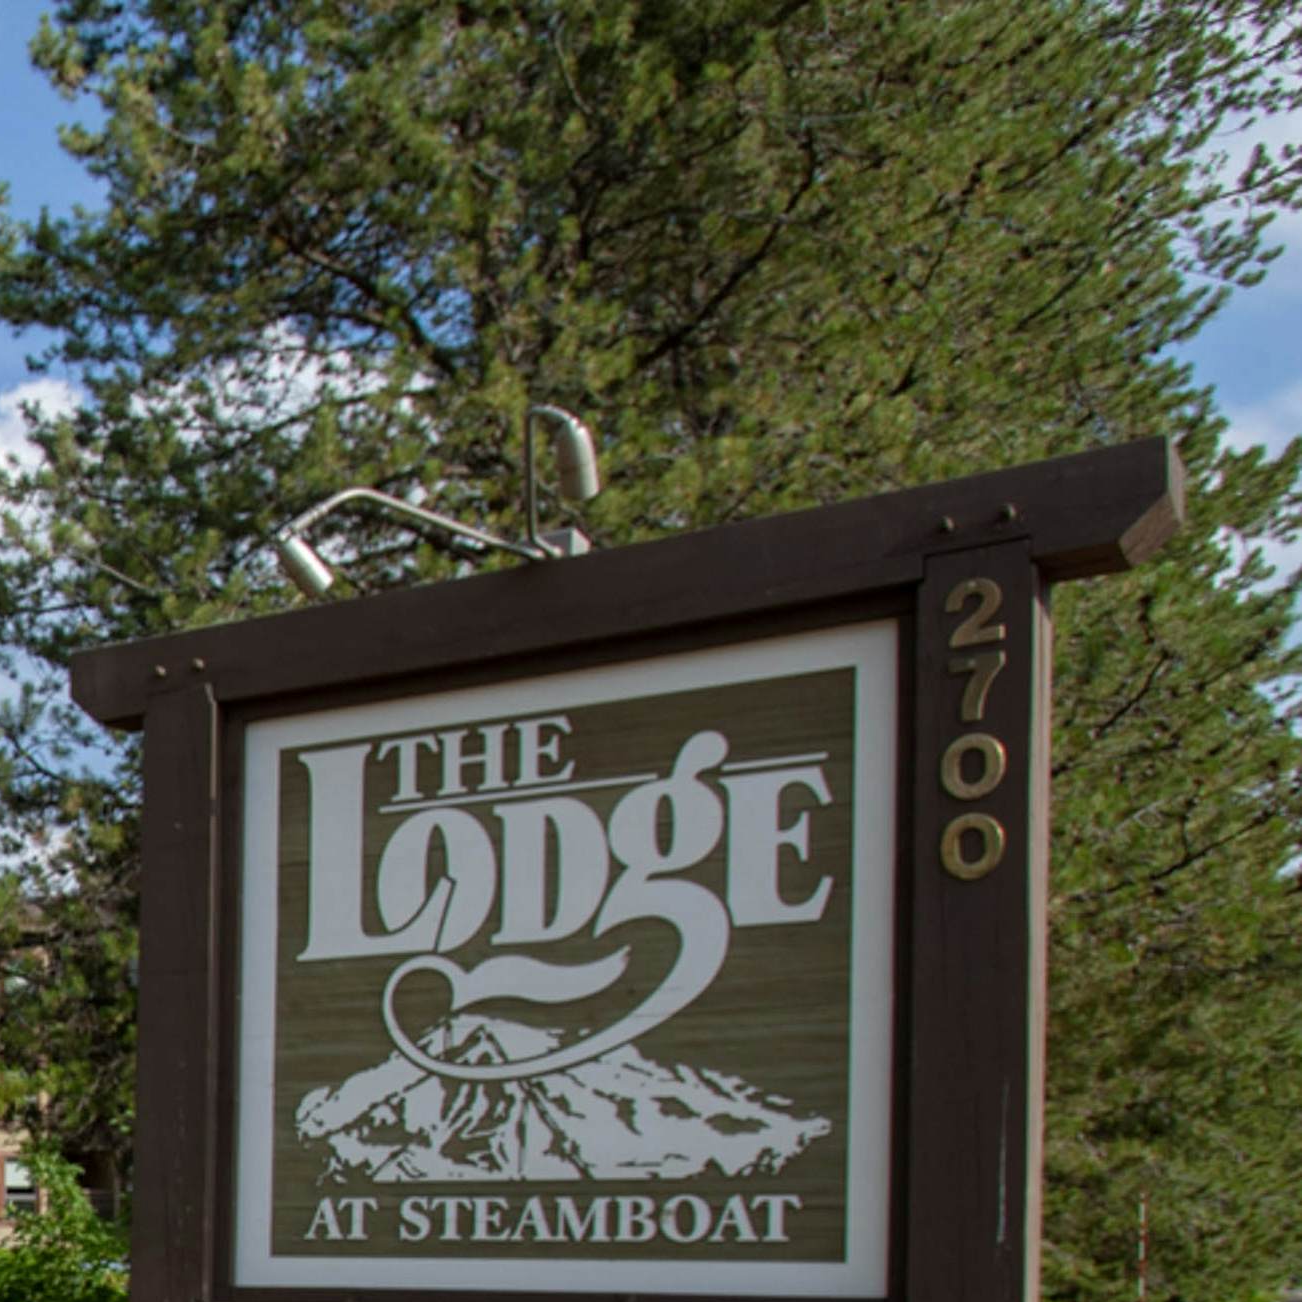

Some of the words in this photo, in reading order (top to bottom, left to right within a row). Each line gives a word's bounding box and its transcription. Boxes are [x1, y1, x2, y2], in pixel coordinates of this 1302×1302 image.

[378, 714, 577, 801] THE
[941, 577, 1007, 879] 2700
[305, 1198, 377, 1241] AT
[399, 1194, 801, 1243] STEAMBOAT
